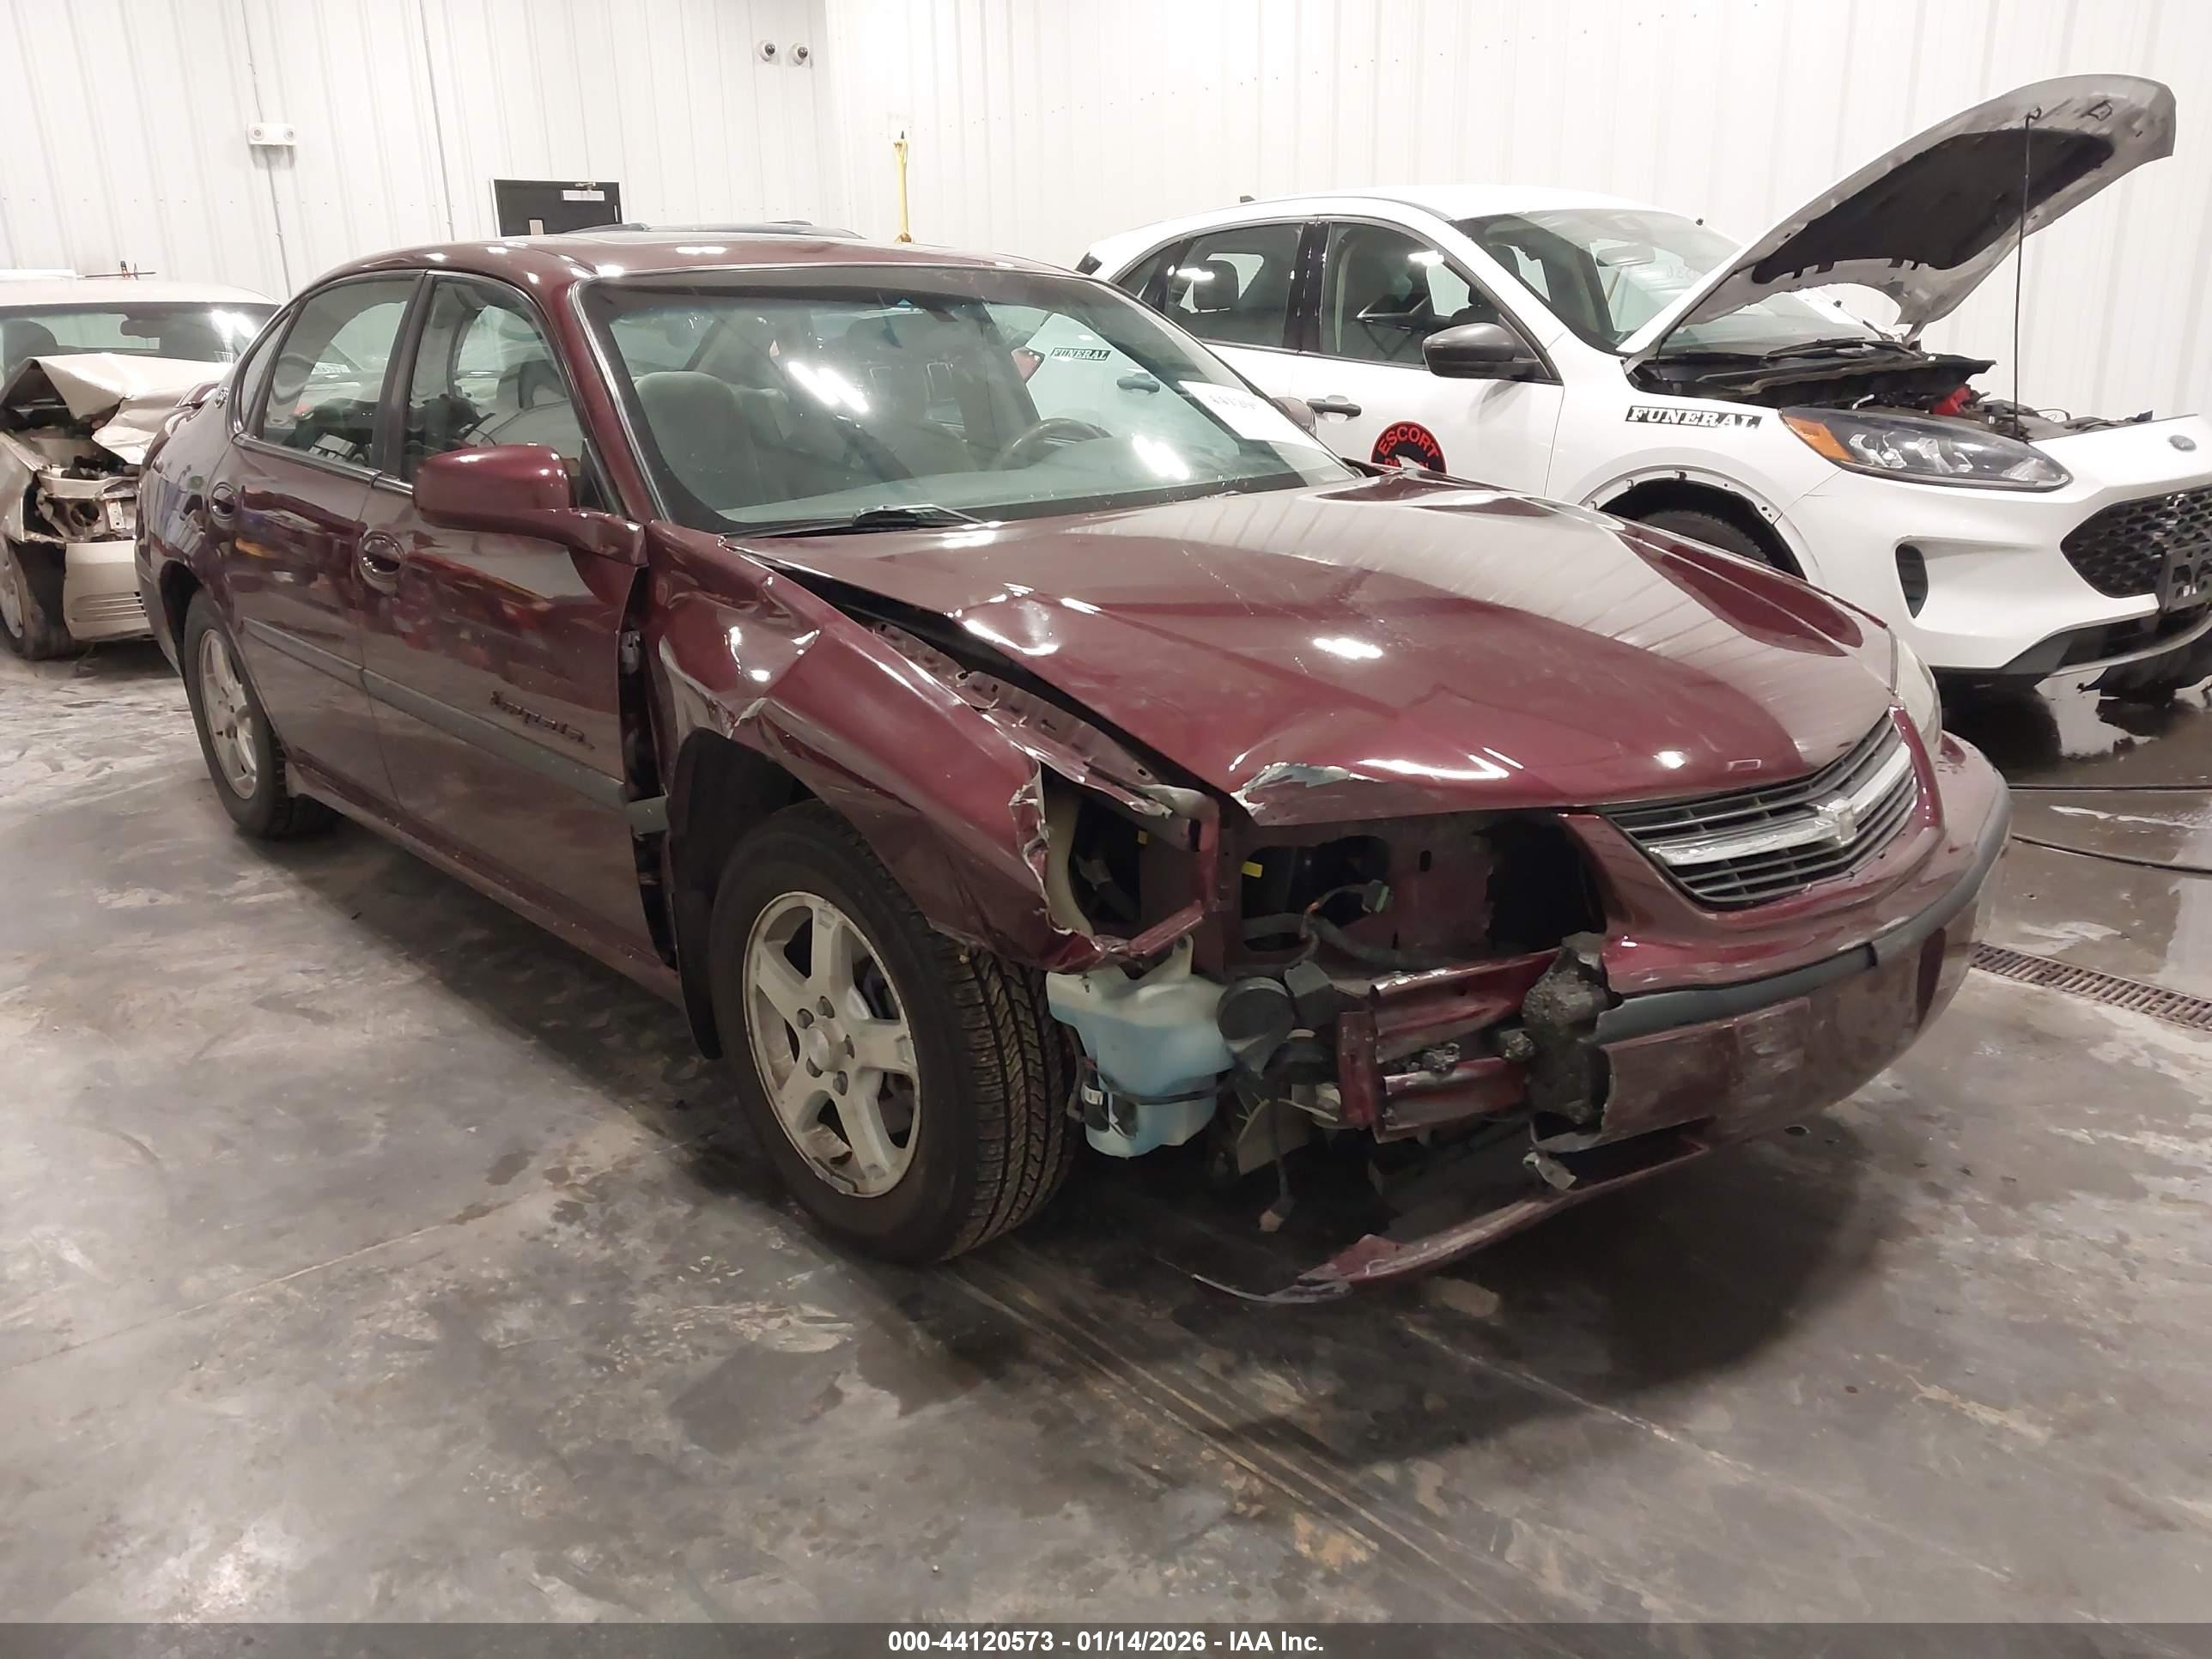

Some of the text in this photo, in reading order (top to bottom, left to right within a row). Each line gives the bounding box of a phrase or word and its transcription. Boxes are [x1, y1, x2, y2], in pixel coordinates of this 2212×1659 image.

[1051, 348, 1109, 360] FUNERAL
[1627, 406, 1758, 429] FUNERAL
[1378, 426, 1438, 458] ESCORT
